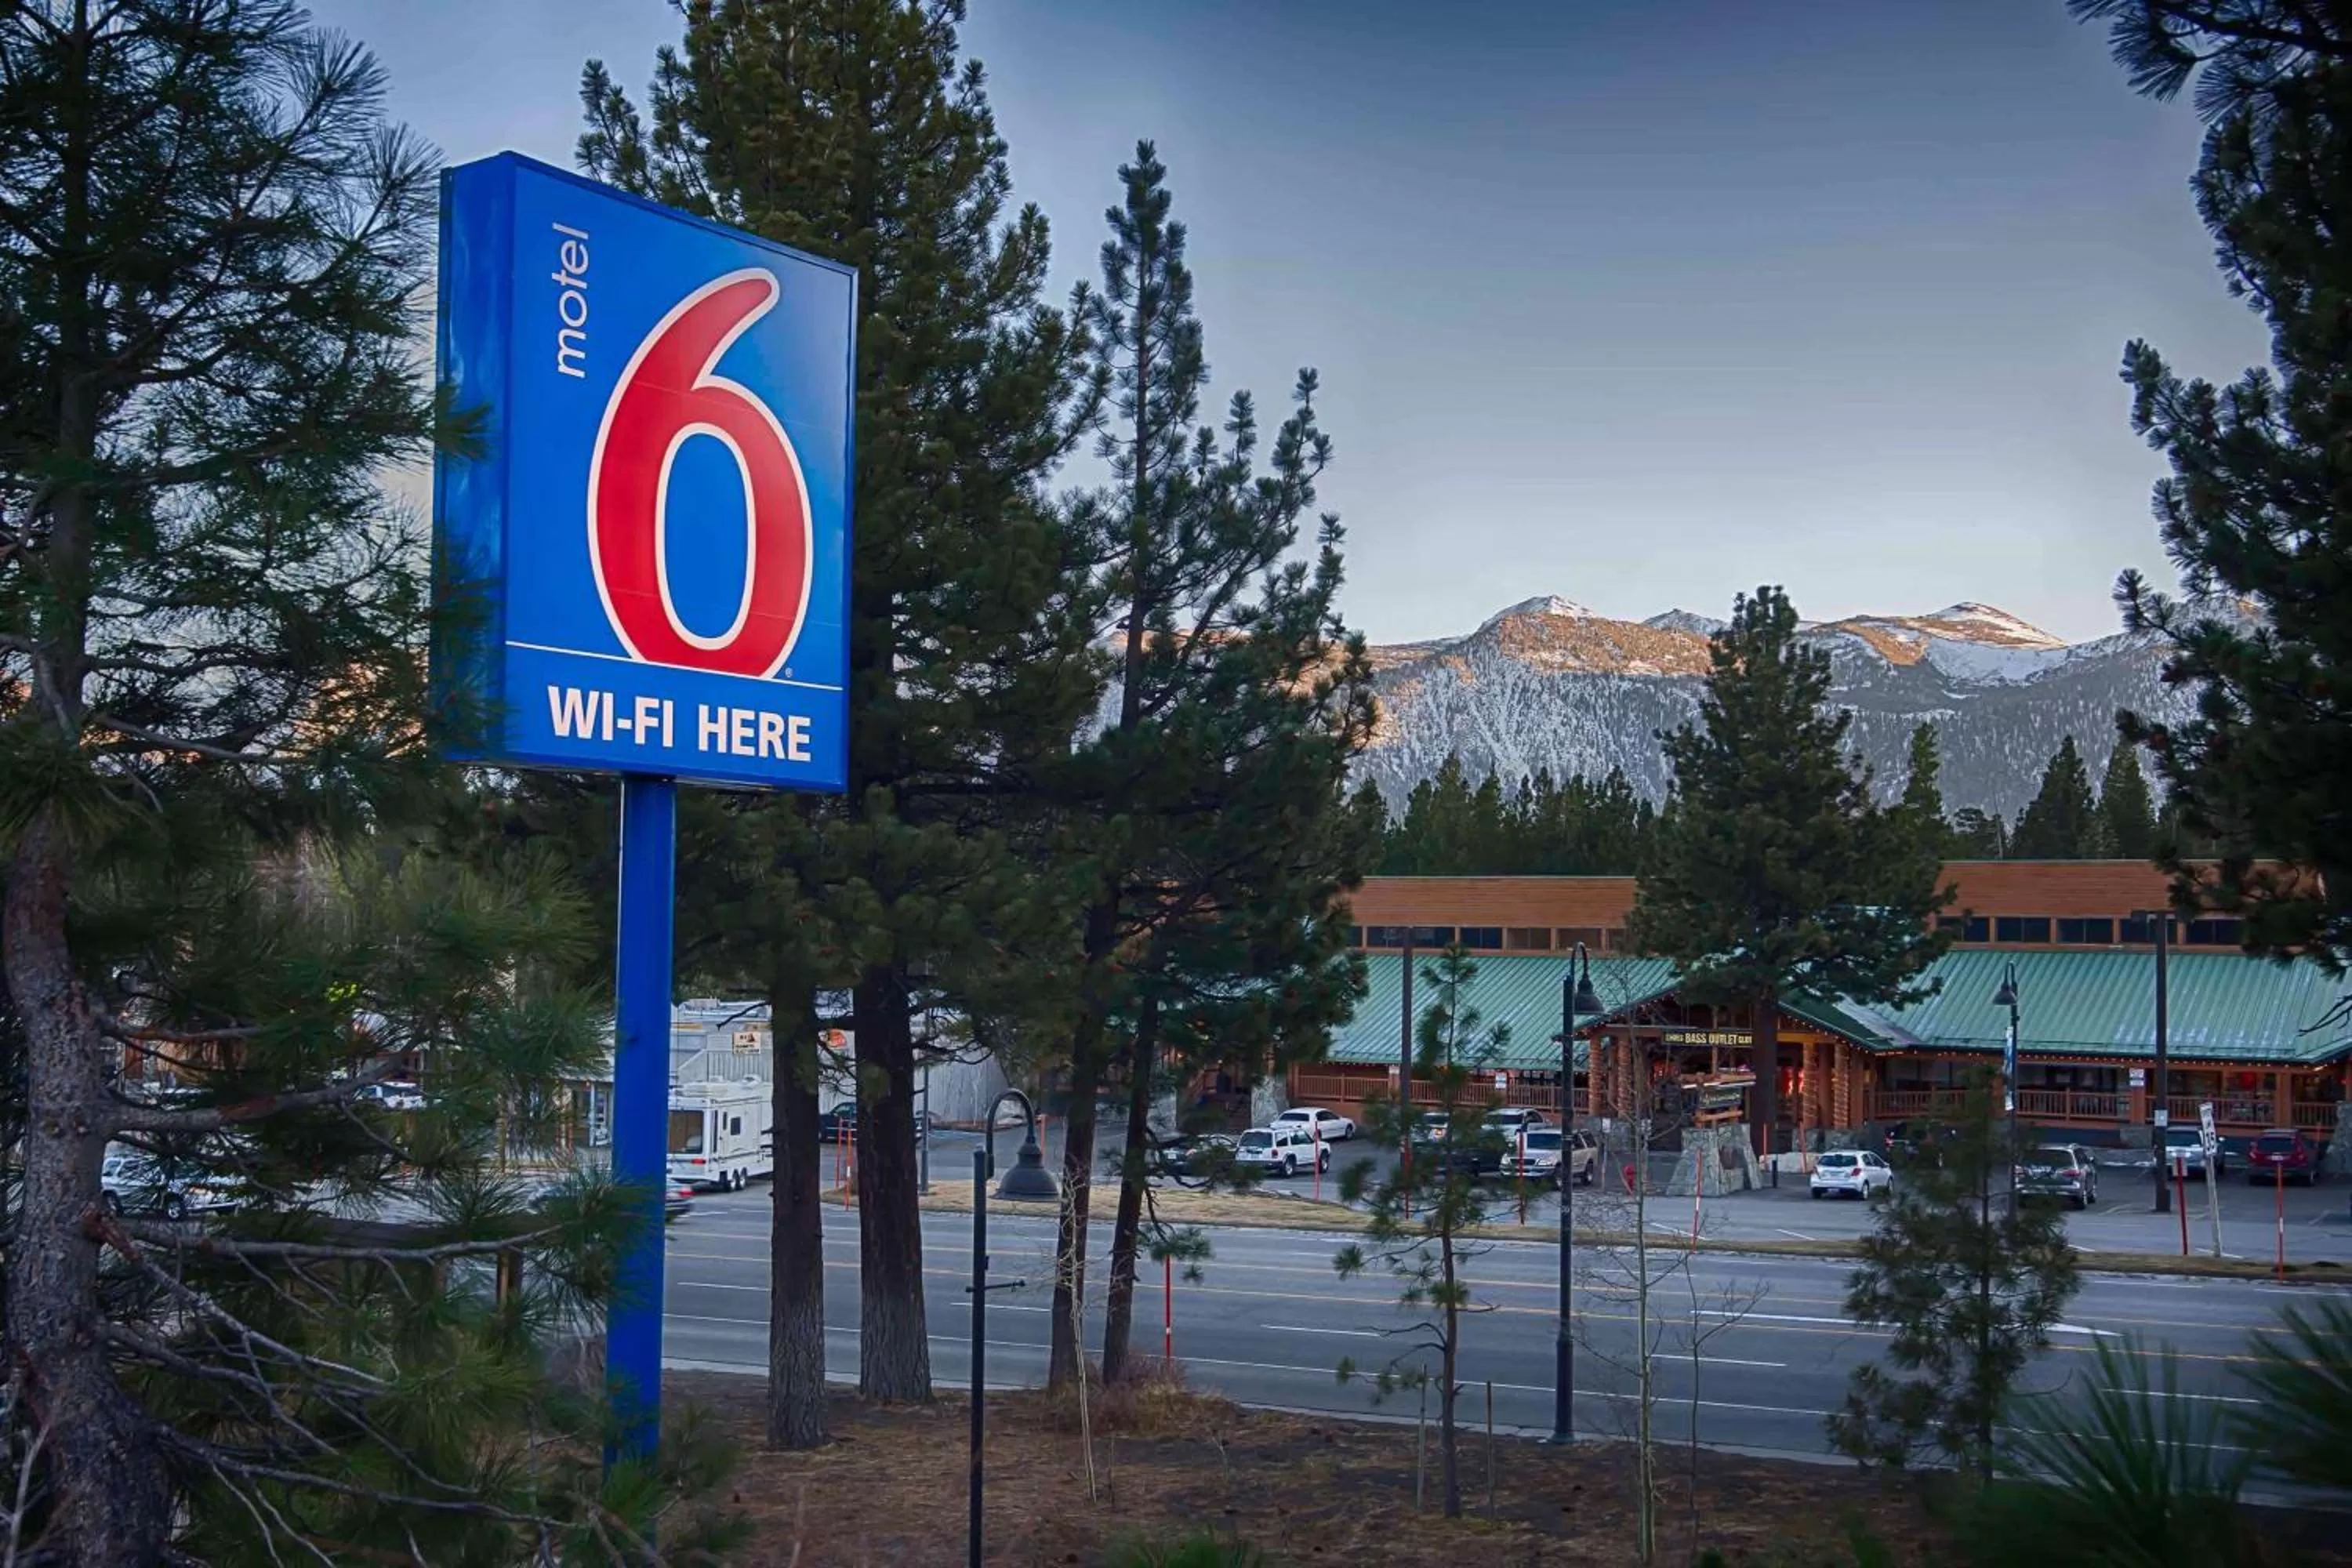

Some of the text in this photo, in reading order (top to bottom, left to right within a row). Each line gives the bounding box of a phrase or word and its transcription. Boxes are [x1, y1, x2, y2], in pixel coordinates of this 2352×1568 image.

[552, 222, 589, 379] motel
[587, 267, 814, 680] 6
[548, 685, 811, 762] WI-FI HERE
[1685, 1033, 1707, 1044] BASS
[1709, 1033, 1737, 1045] OUTLET
